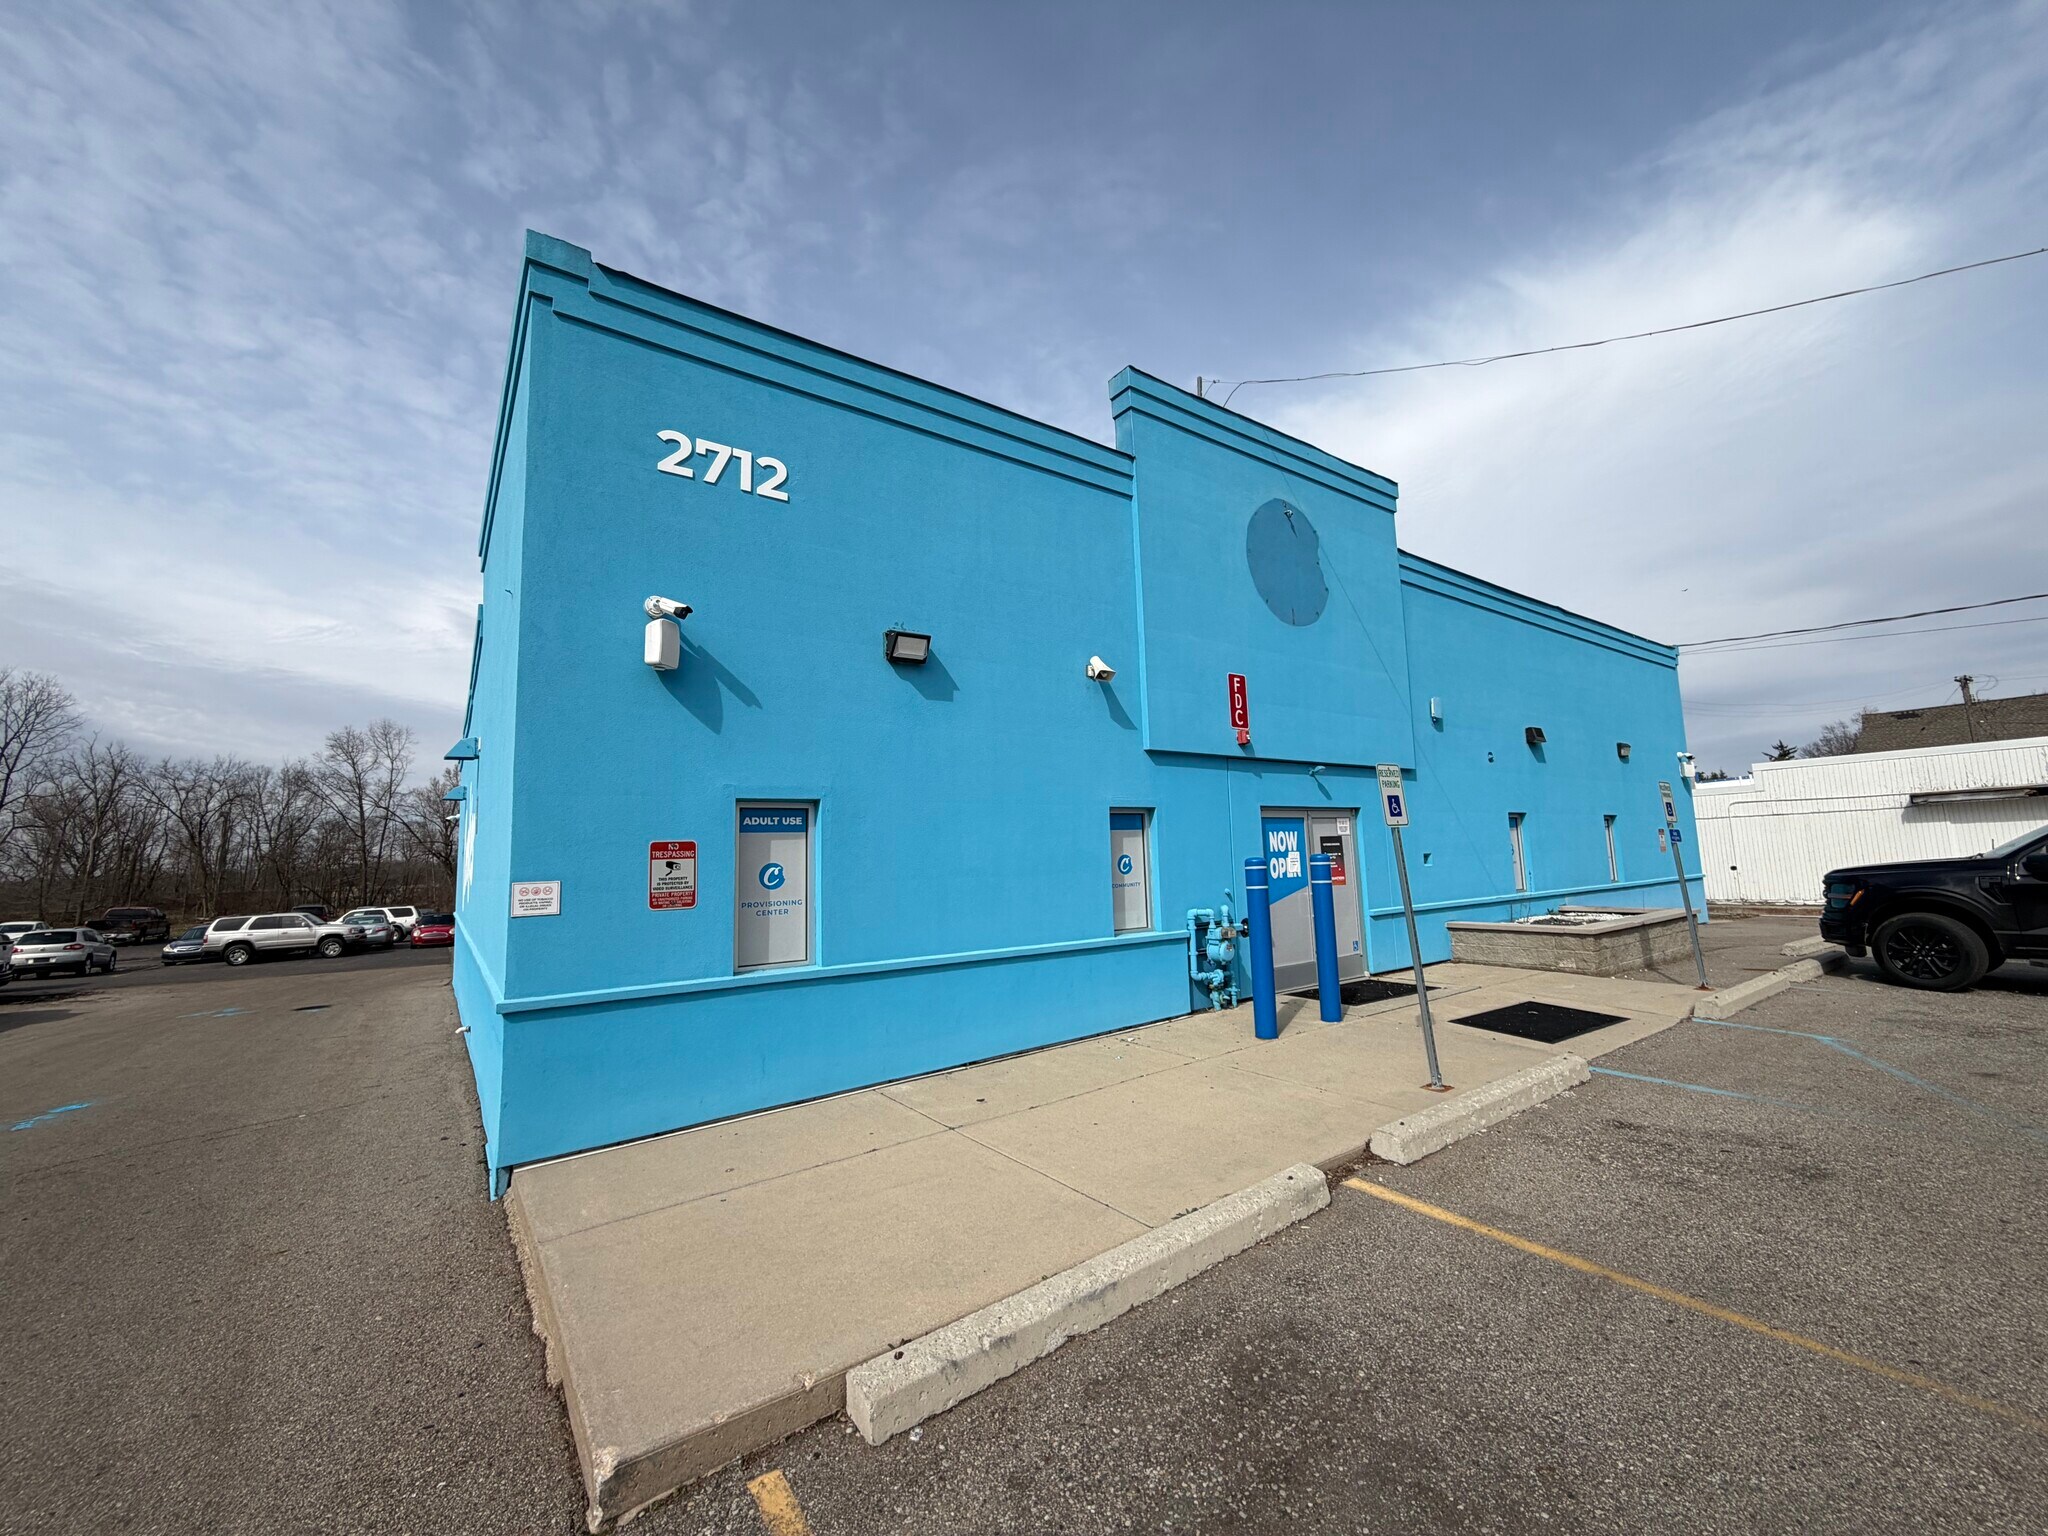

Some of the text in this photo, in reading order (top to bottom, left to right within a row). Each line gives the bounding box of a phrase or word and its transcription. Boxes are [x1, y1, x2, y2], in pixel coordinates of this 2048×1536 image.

[656, 429, 789, 502] 2712
[1233, 677, 1244, 726] FDC
[1378, 769, 1401, 778] RESERVED
[1381, 779, 1401, 788] PARKING
[743, 816, 803, 826] ADULT USE
[1268, 831, 1298, 852] NOW
[652, 850, 695, 858] TRESPASSING
[763, 866, 782, 886] C
[741, 899, 803, 909] PROVISIONING
[756, 908, 789, 917] CENTER
